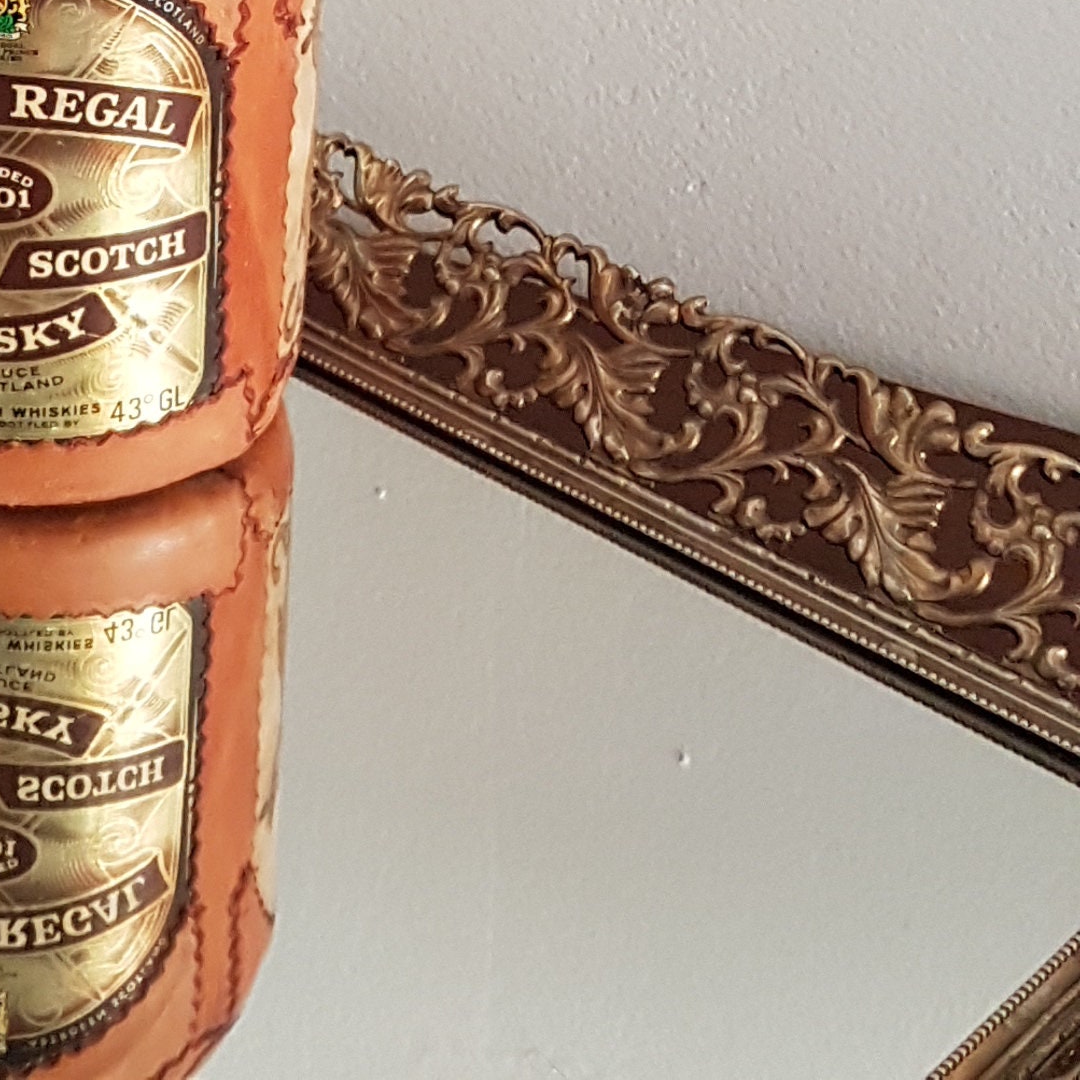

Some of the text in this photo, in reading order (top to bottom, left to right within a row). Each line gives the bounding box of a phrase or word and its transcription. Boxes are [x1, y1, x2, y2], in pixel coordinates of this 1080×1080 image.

[10, 83, 176, 136] REGAL
[28, 228, 186, 280] SCOTCH
[12, 402, 101, 418] WHISKIES
[159, 385, 186, 412] GL
